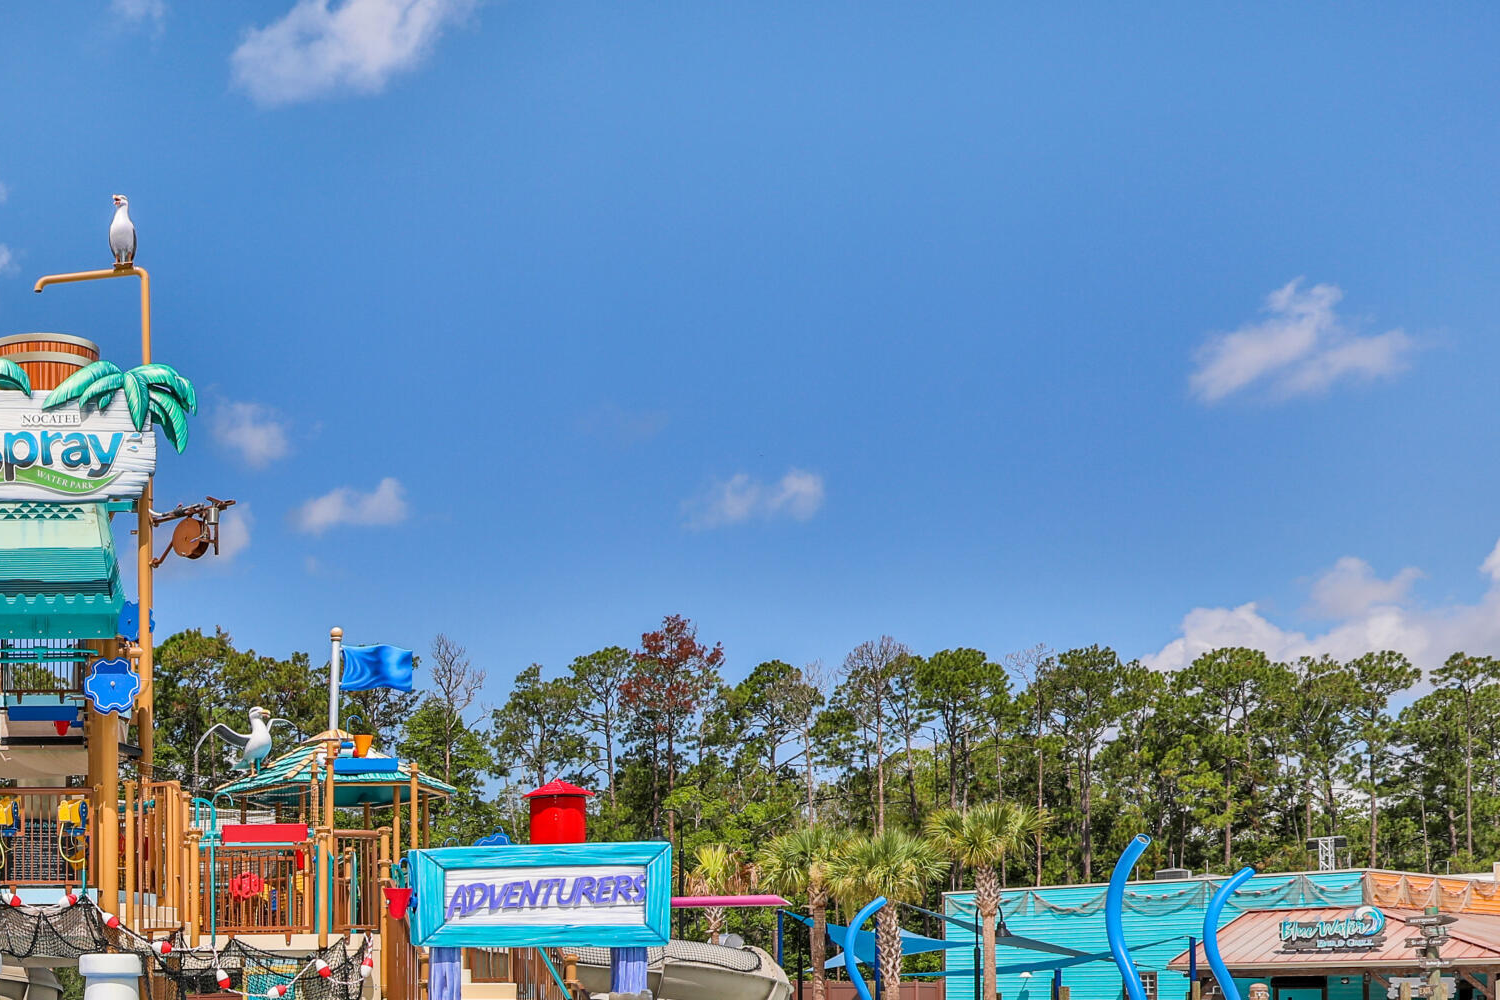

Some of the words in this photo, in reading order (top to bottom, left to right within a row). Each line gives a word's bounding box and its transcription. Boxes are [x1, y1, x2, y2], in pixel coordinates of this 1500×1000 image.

[22, 413, 80, 424] NOCATEE
[36, 469, 68, 487] WATER
[70, 481, 94, 490] PARK
[445, 874, 646, 921] ADVENTURERS
[1281, 921, 1318, 941] Blue
[1317, 918, 1370, 939] Water
